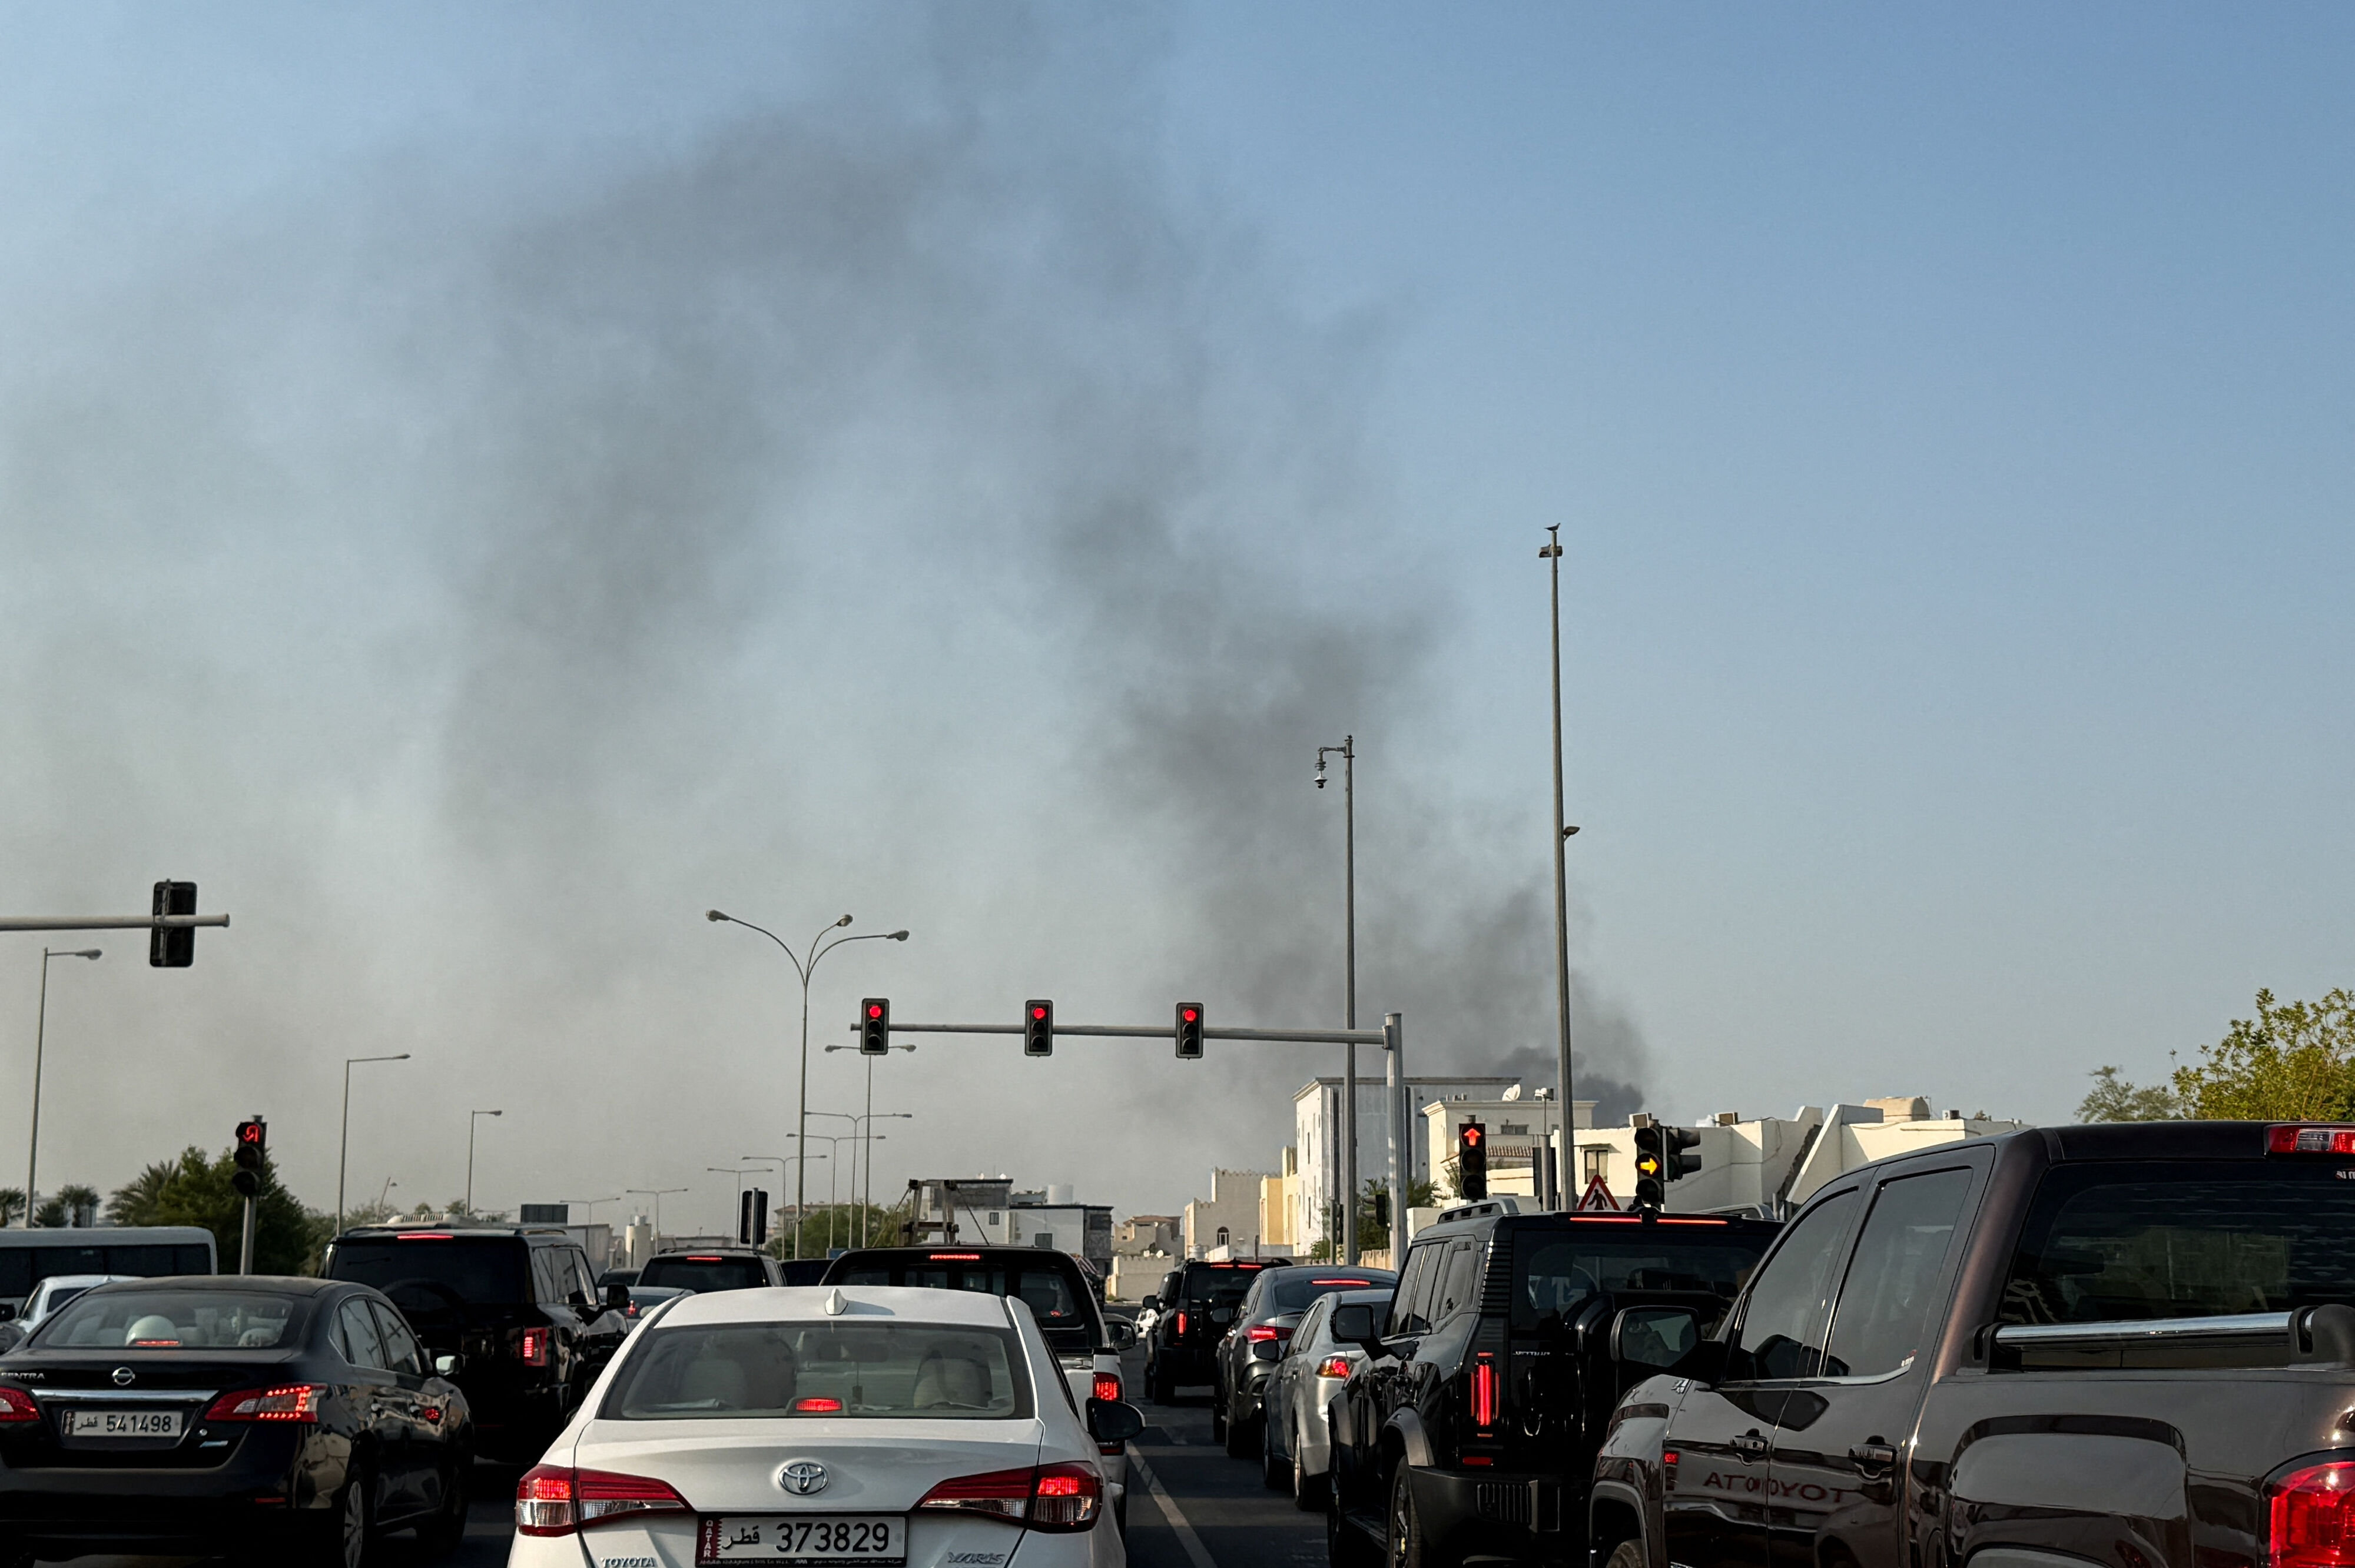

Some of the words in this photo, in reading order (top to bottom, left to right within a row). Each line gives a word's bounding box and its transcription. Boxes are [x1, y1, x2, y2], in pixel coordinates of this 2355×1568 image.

[76, 1416, 98, 1431] قطر
[106, 1415, 172, 1433] 541498
[703, 1520, 714, 1557] QATAR
[721, 1525, 760, 1550] قطر
[775, 1523, 890, 1552] 373829
[600, 1557, 658, 1568] TOYOTA
[947, 1552, 1006, 1564] YARIS
